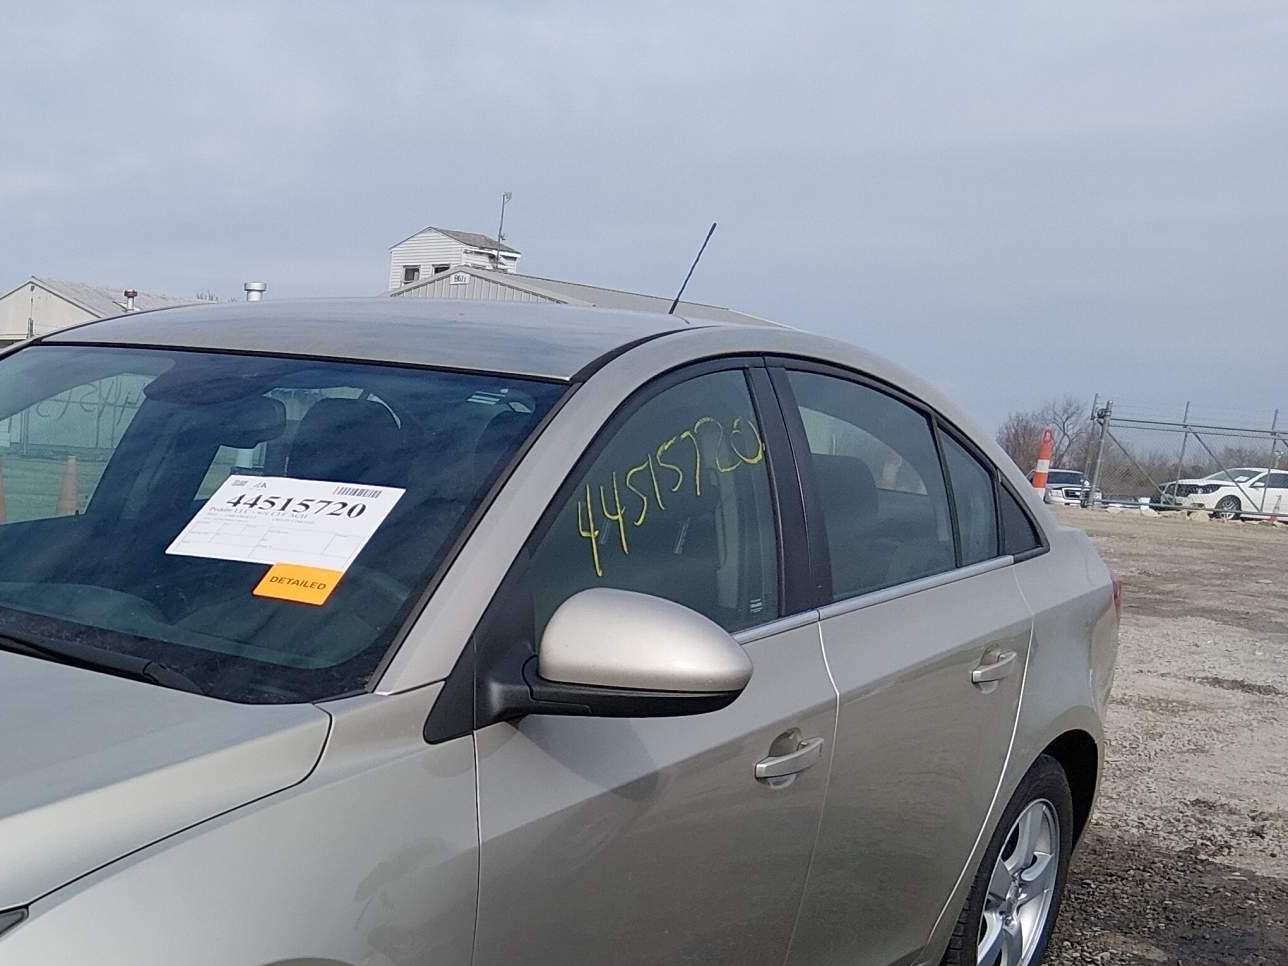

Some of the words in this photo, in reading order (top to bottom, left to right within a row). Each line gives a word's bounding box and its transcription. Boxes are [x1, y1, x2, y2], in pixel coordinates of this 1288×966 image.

[226, 493, 367, 520] 44515720
[577, 416, 765, 577] 44515720
[269, 575, 327, 591] DETAILED
